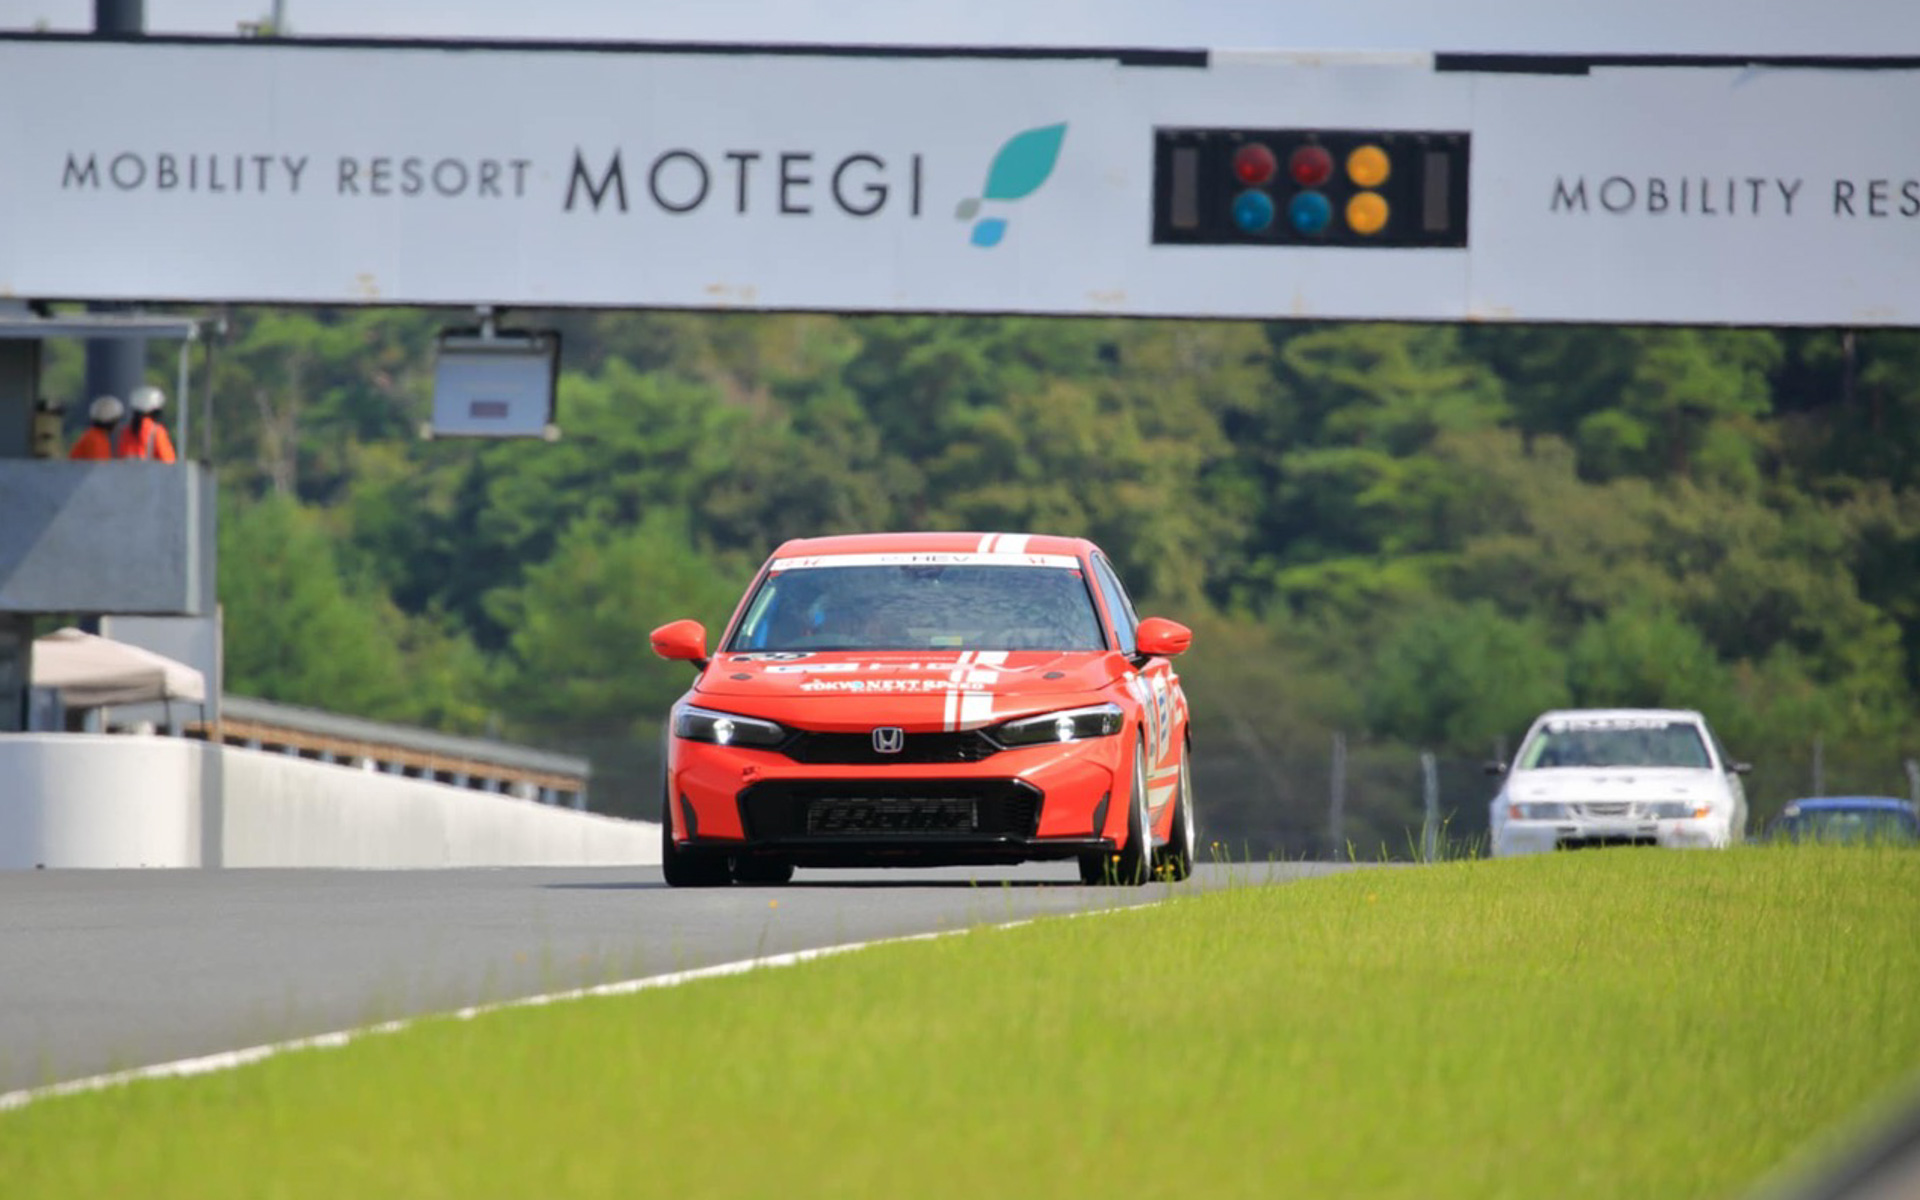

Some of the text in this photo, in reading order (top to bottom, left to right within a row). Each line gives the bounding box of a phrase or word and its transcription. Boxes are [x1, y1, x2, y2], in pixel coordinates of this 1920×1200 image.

[62, 147, 922, 218] MOBILITY RESORT MOTEGI
[1551, 175, 1804, 216] MOBILITY
